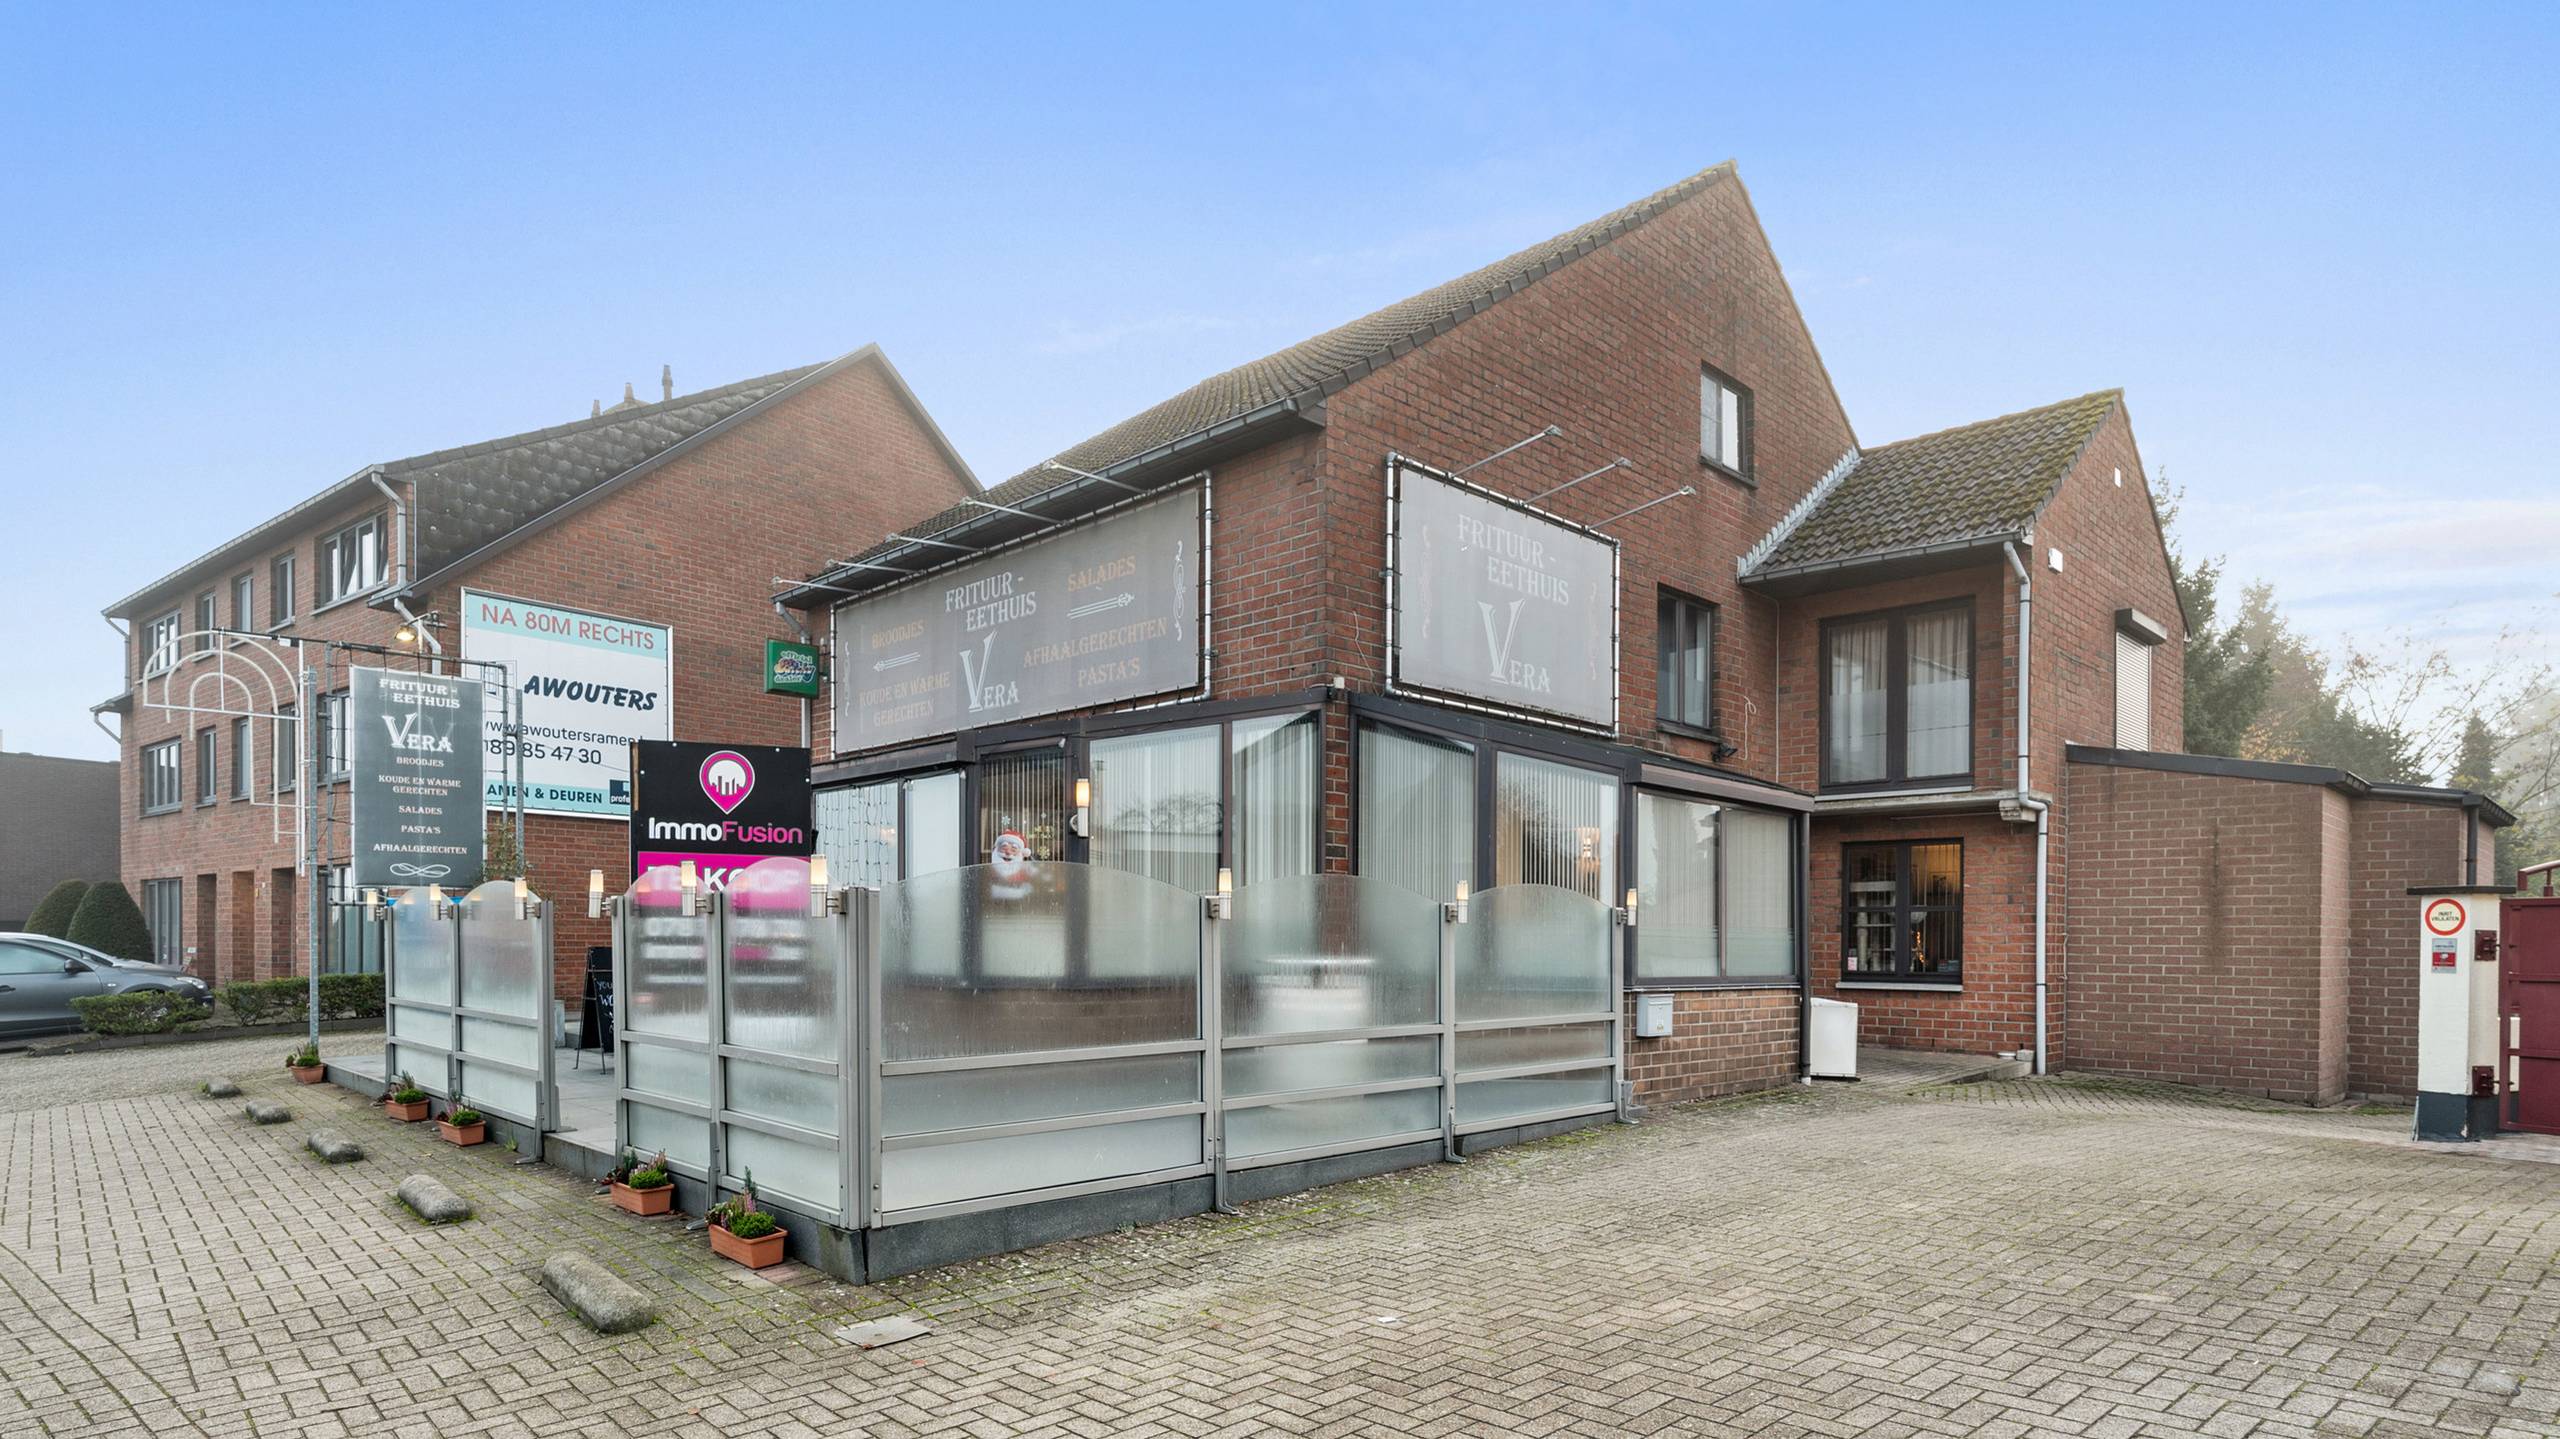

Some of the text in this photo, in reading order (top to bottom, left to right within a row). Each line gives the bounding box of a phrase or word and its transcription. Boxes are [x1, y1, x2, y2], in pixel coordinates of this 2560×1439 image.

[1458, 515, 1545, 569] FRITUUR
[1067, 554, 1137, 593] SALADES
[1487, 555, 1570, 606] EETHUIS
[945, 571, 1015, 613] FRITUUR
[966, 591, 1038, 632] EETHUIS
[482, 603, 655, 650] NA 80M RECHTS
[871, 618, 927, 650] BROODJES
[1023, 616, 1169, 669] AFHAALGERECHTEN
[895, 681, 909, 700] EN
[910, 671, 951, 696] WARME
[1077, 656, 1141, 688] PASTA'S
[379, 678, 448, 696] FRITUUR
[392, 692, 461, 709] EETHUIS
[523, 675, 658, 711] AWOUTERS
[872, 698, 935, 728] GERECHTEN
[396, 756, 445, 768] BROODJES
[522, 741, 546, 759] 85
[550, 746, 574, 762] 47
[578, 748, 602, 765] 30
[378, 775, 462, 788] KOUDE EN WARME
[392, 785, 448, 796] GERECHTEN
[534, 787, 545, 800] &
[549, 789, 603, 804] DEUREN
[398, 805, 443, 815] SALADES
[401, 825, 441, 834] PASTA'S
[648, 816, 804, 844] ImmoFusion
[373, 843, 468, 855] AFHAALGERECHTEN
